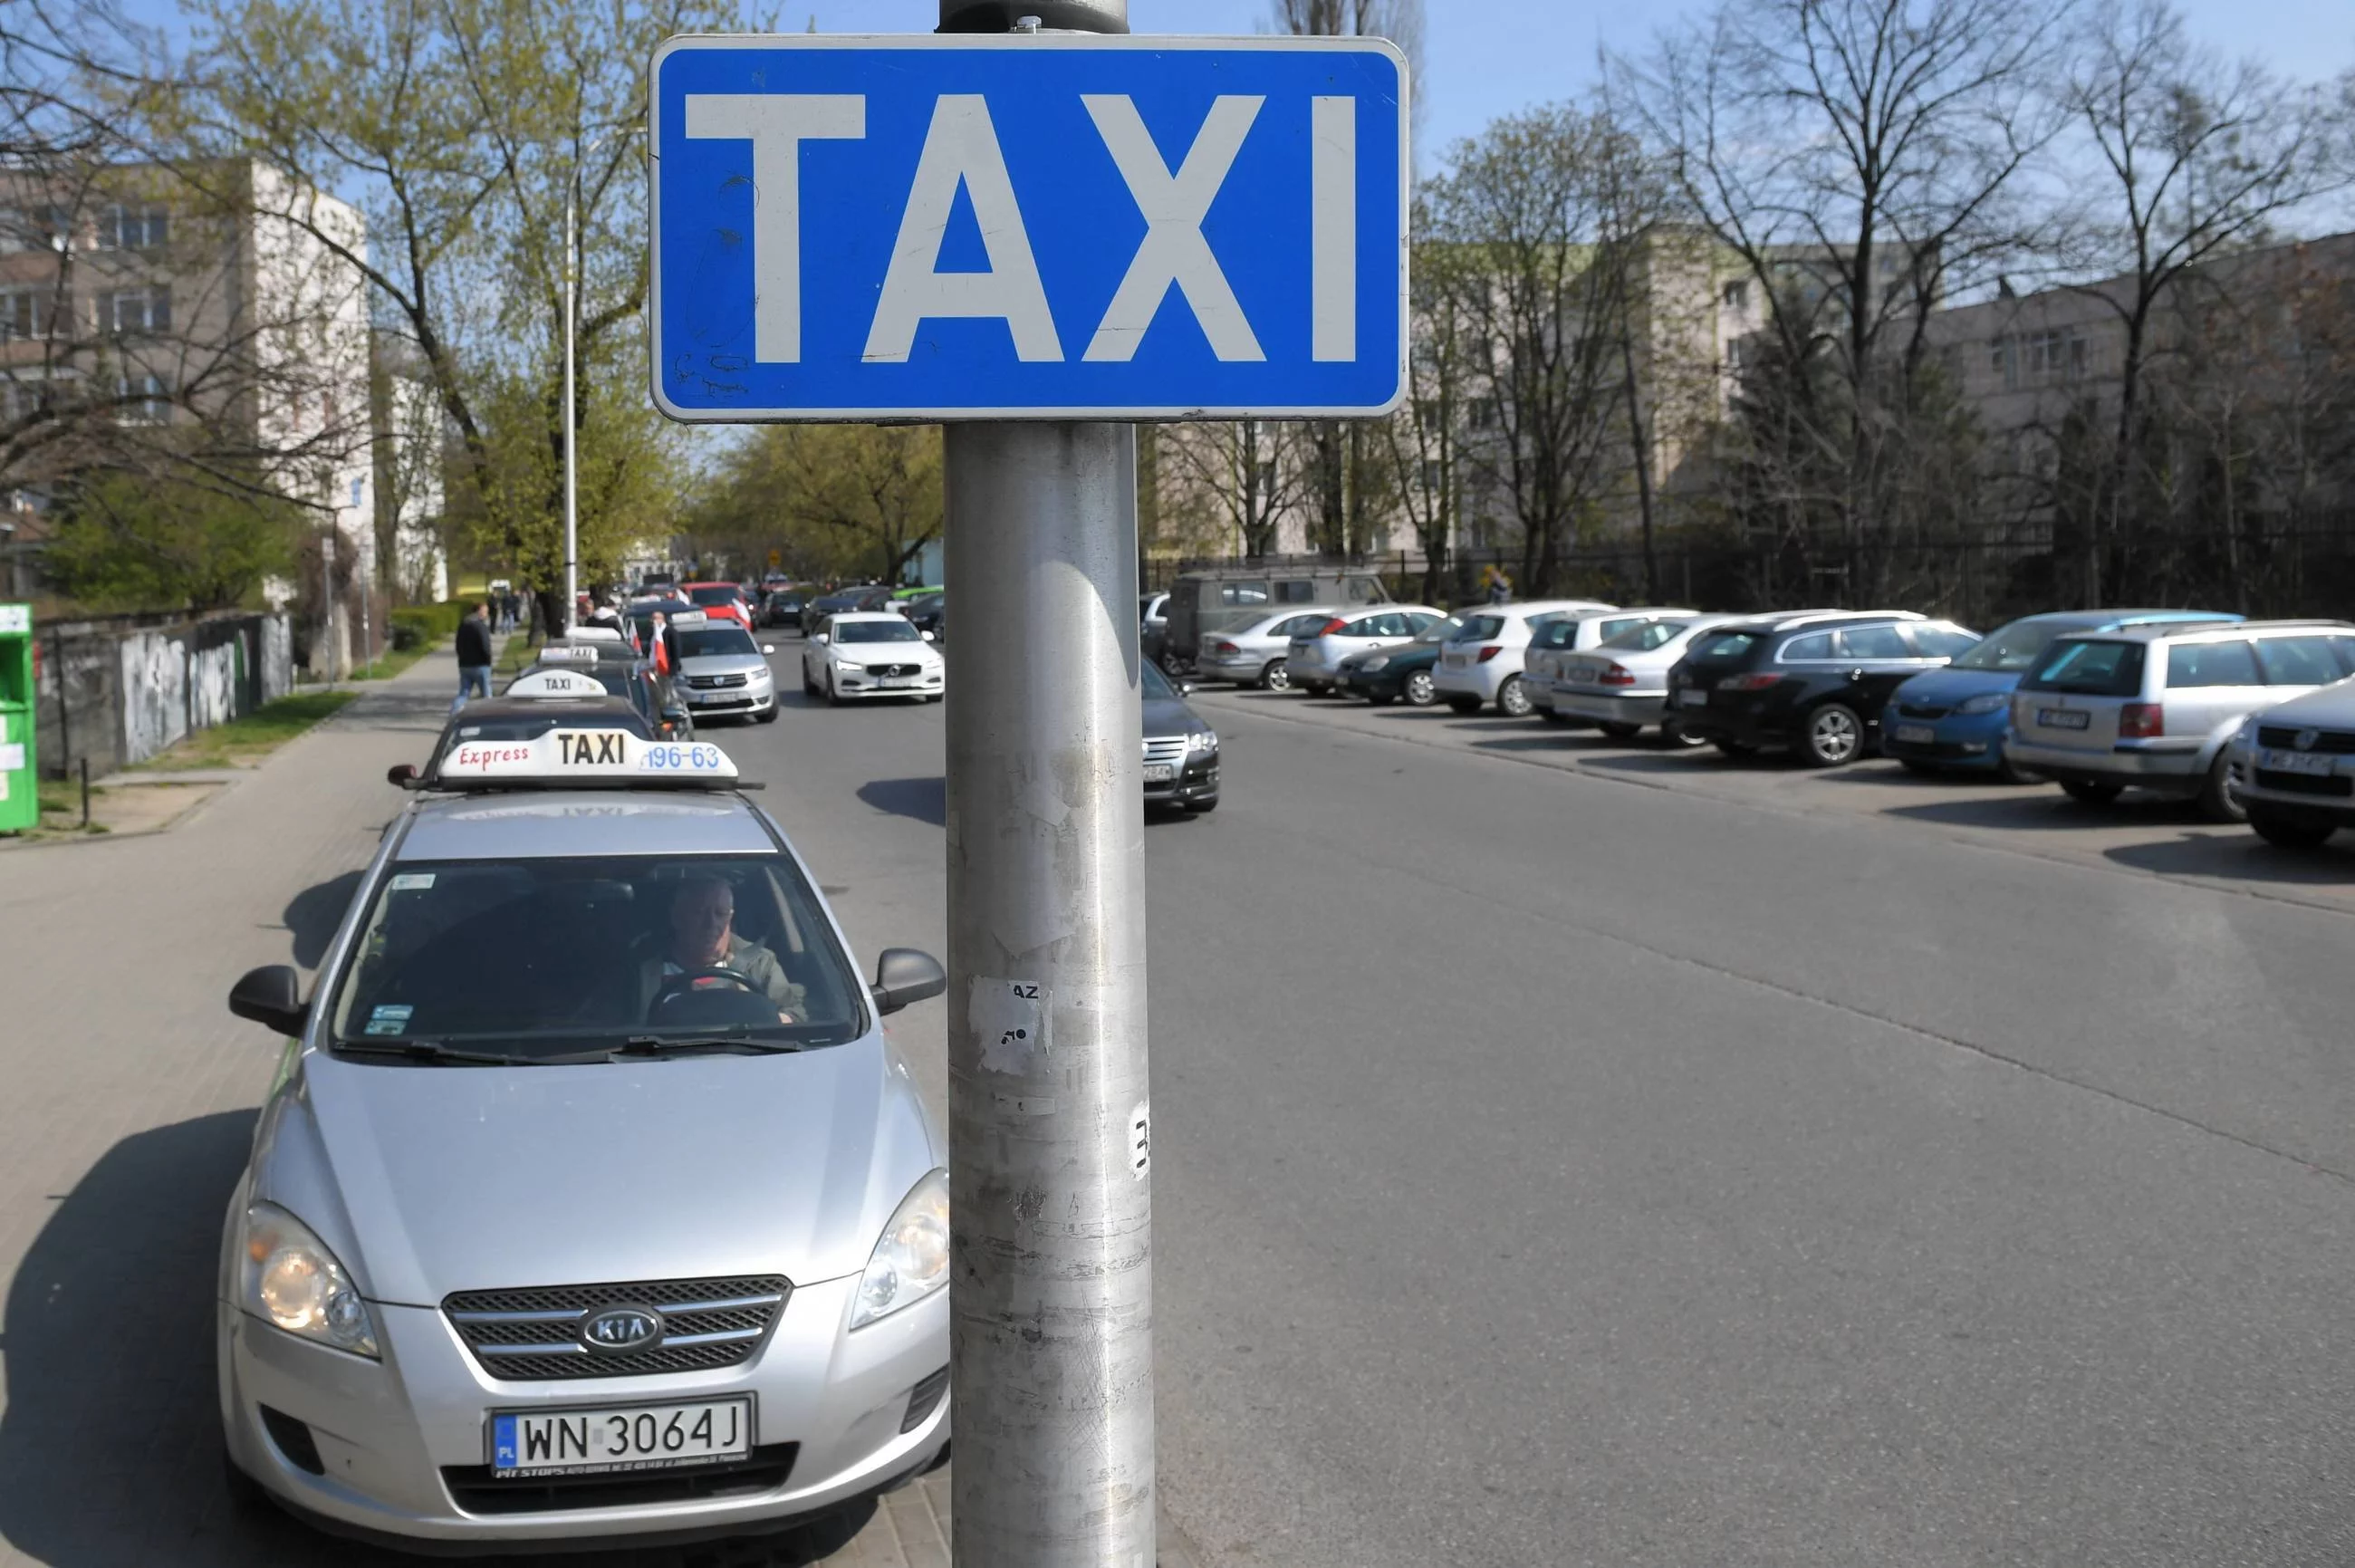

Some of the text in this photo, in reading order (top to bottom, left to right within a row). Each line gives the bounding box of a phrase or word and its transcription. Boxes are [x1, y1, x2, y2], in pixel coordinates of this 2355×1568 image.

[685, 93, 1356, 363] TAXI
[545, 678, 572, 690] TAXI
[459, 747, 529, 770] Express
[558, 734, 625, 765] TAXI
[597, 1318, 646, 1340] KIA
[524, 1406, 737, 1461] WN 3064J
[498, 1448, 514, 1459] PL
